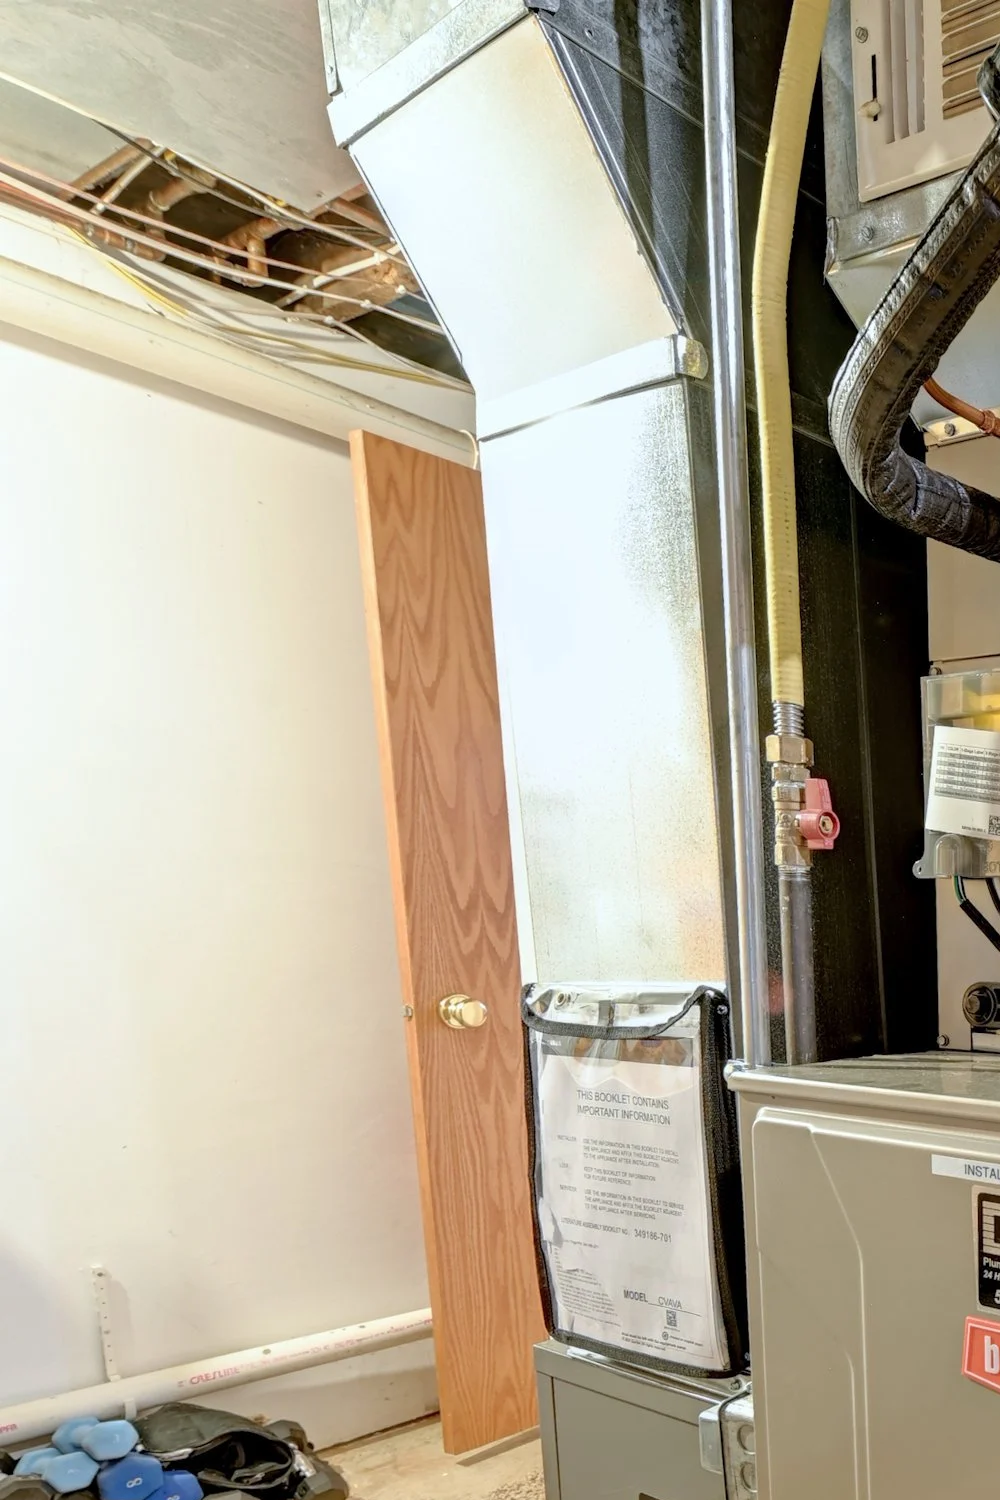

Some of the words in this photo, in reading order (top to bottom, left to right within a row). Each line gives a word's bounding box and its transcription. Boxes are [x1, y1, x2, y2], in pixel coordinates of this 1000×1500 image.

[577, 1090, 592, 1100] THIS
[595, 1091, 630, 1104] BOOKLET
[632, 1096, 669, 1110] CONTAINS
[577, 1105, 619, 1118] IMPORTANT
[622, 1110, 671, 1125] INFORMATION
[635, 1228, 672, 1243] 349186-701
[983, 1270, 992, 1279] 24
[623, 1289, 648, 1302] MODEL
[658, 1296, 682, 1309] CVAVA
[126, 1477, 143, 1488] 8
